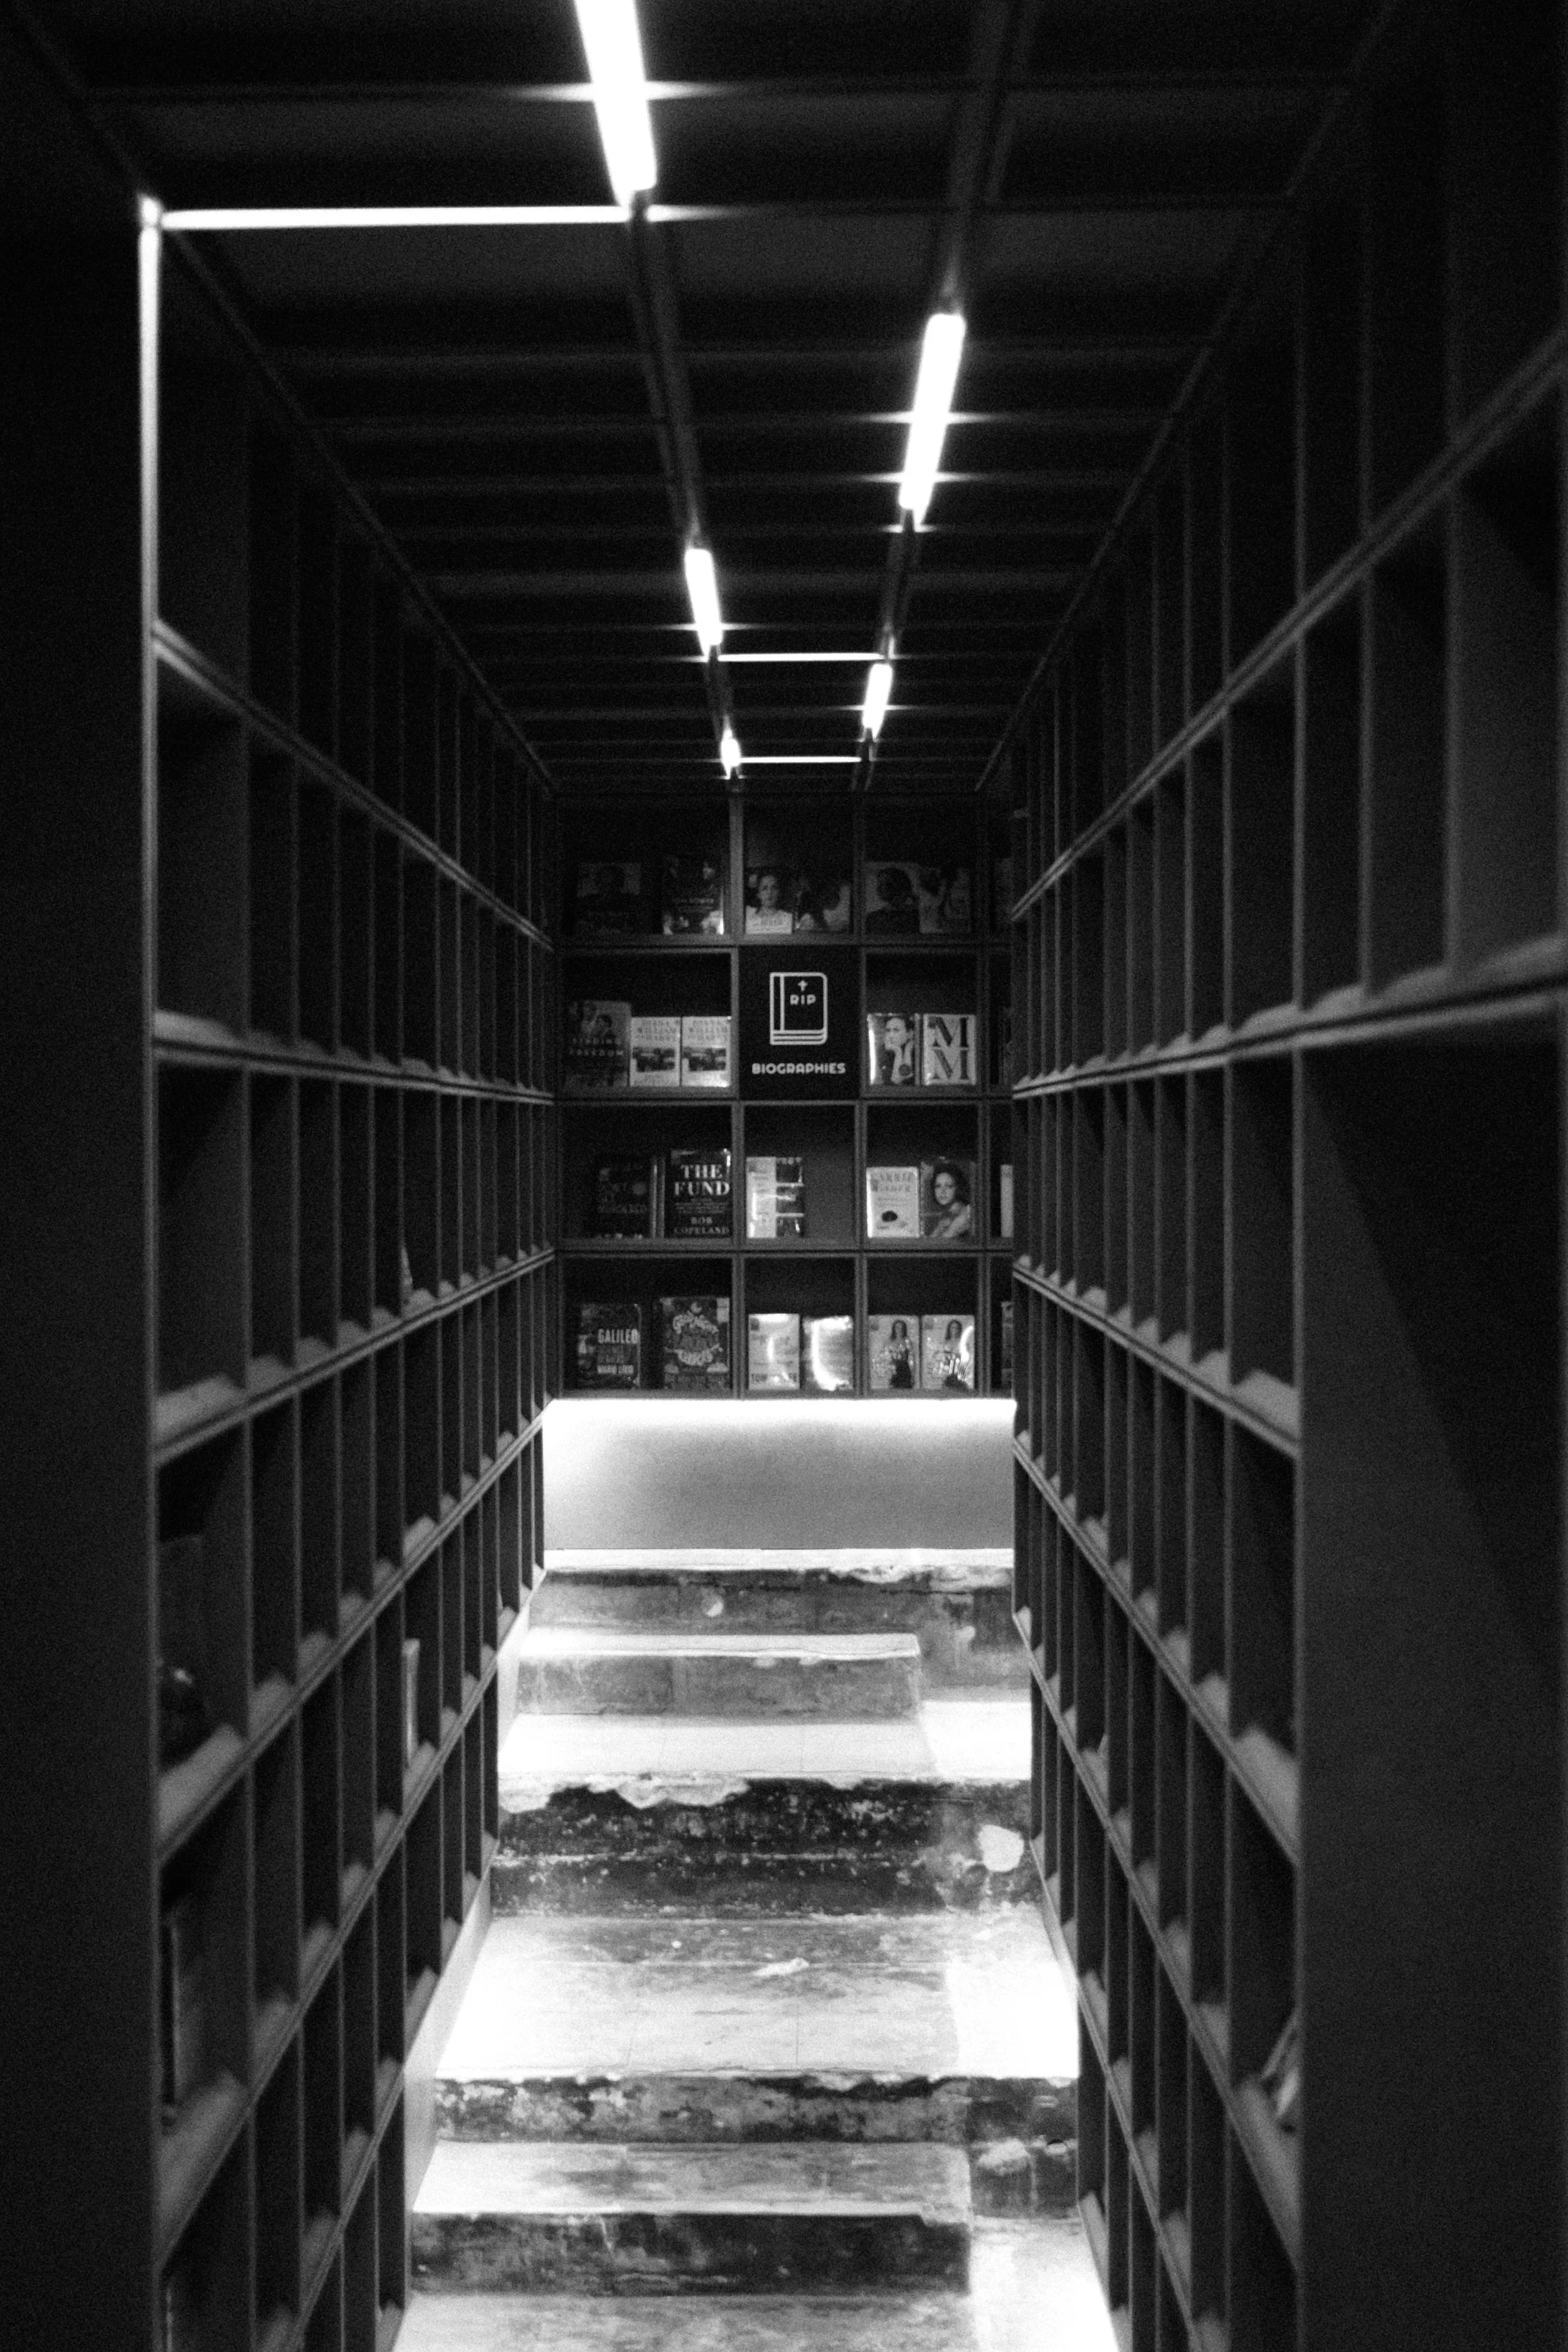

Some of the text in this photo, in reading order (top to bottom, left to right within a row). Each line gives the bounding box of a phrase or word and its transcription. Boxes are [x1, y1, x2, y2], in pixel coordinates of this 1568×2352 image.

[790, 994, 816, 1005] RIP
[751, 1062, 847, 1075] BIOGRAPHIES
[680, 1164, 723, 1179] THE
[674, 1181, 730, 1196] FUND
[674, 1226, 730, 1235] COPELAND
[597, 1328, 639, 1344] GALILEO
